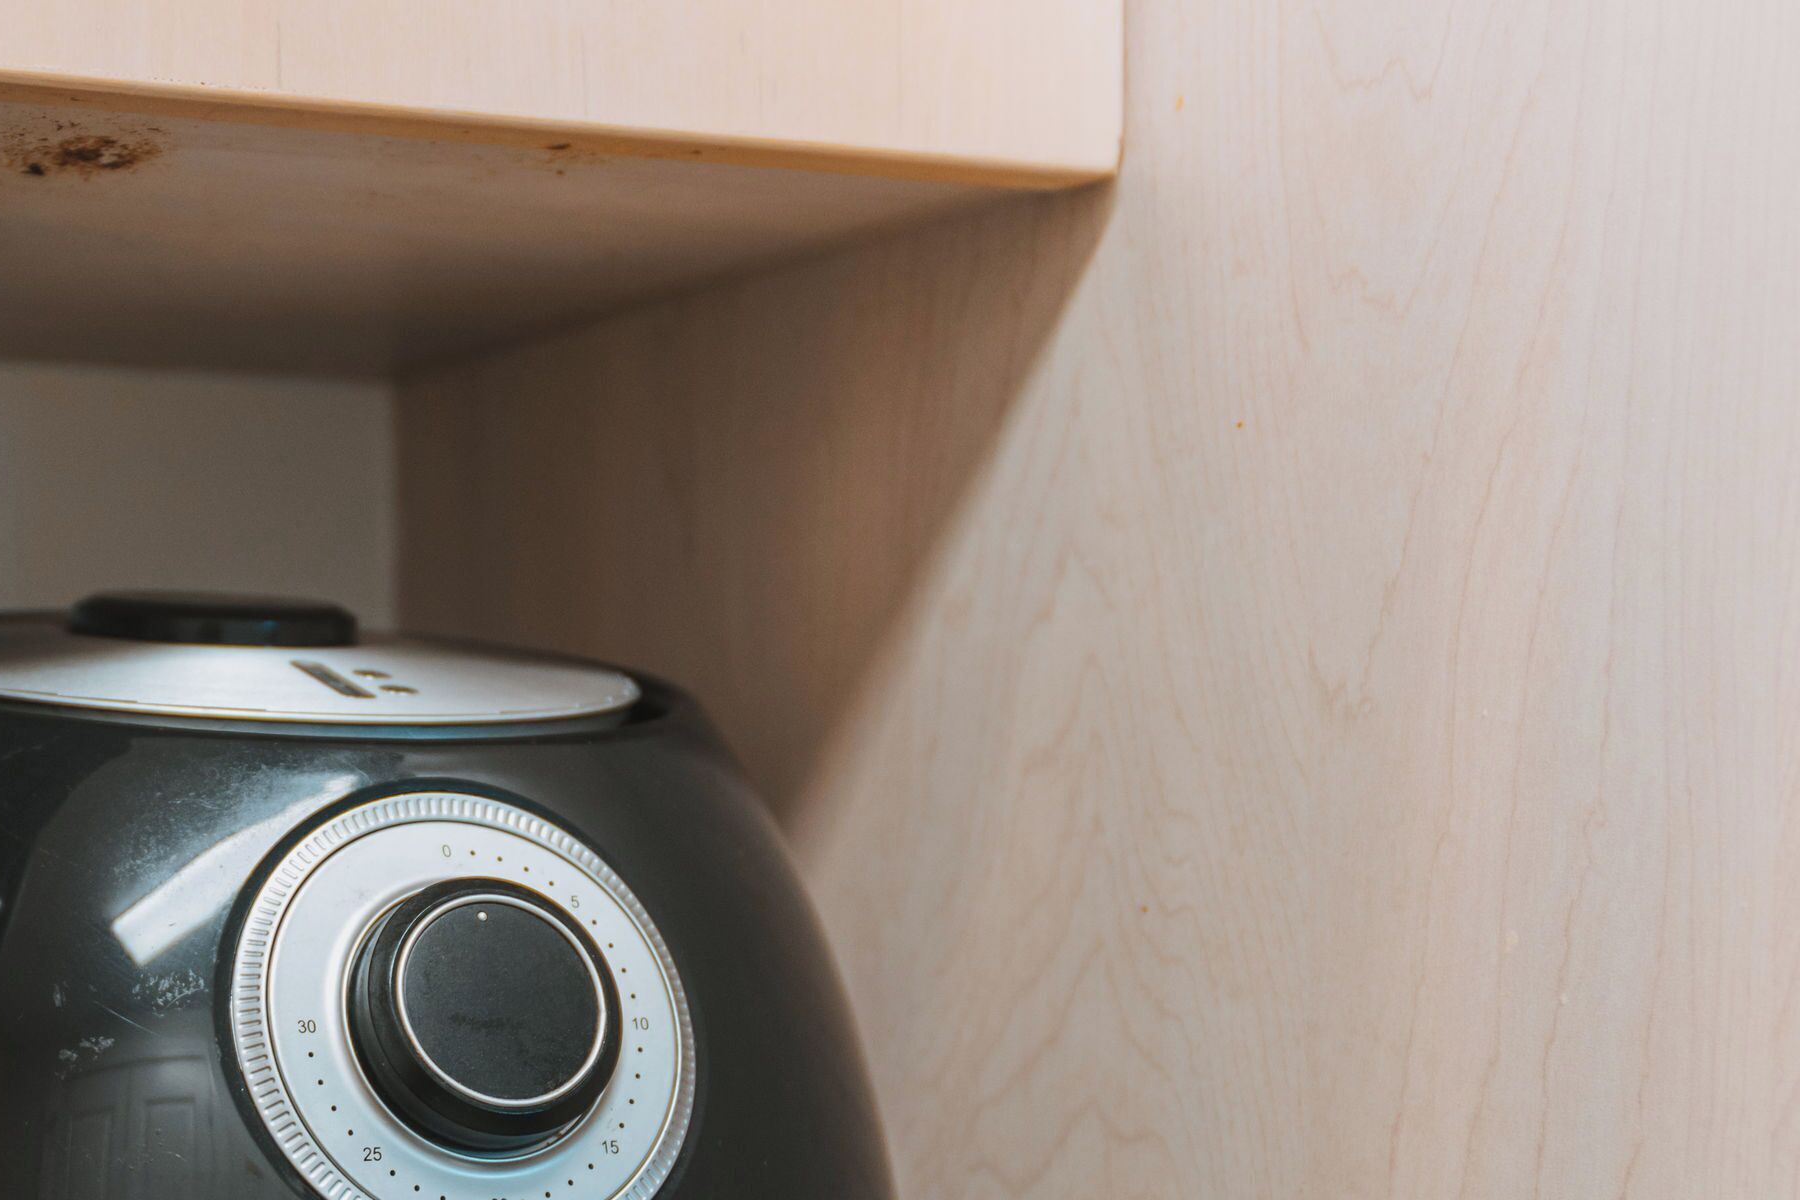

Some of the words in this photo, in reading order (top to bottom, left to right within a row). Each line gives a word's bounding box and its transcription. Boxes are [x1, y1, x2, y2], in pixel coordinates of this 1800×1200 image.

[441, 844, 452, 858] 0
[570, 895, 580, 909] 5
[297, 1019, 317, 1034] 30
[632, 1016, 649, 1031] 10
[362, 1146, 383, 1162] 25
[602, 1140, 620, 1155] 15
